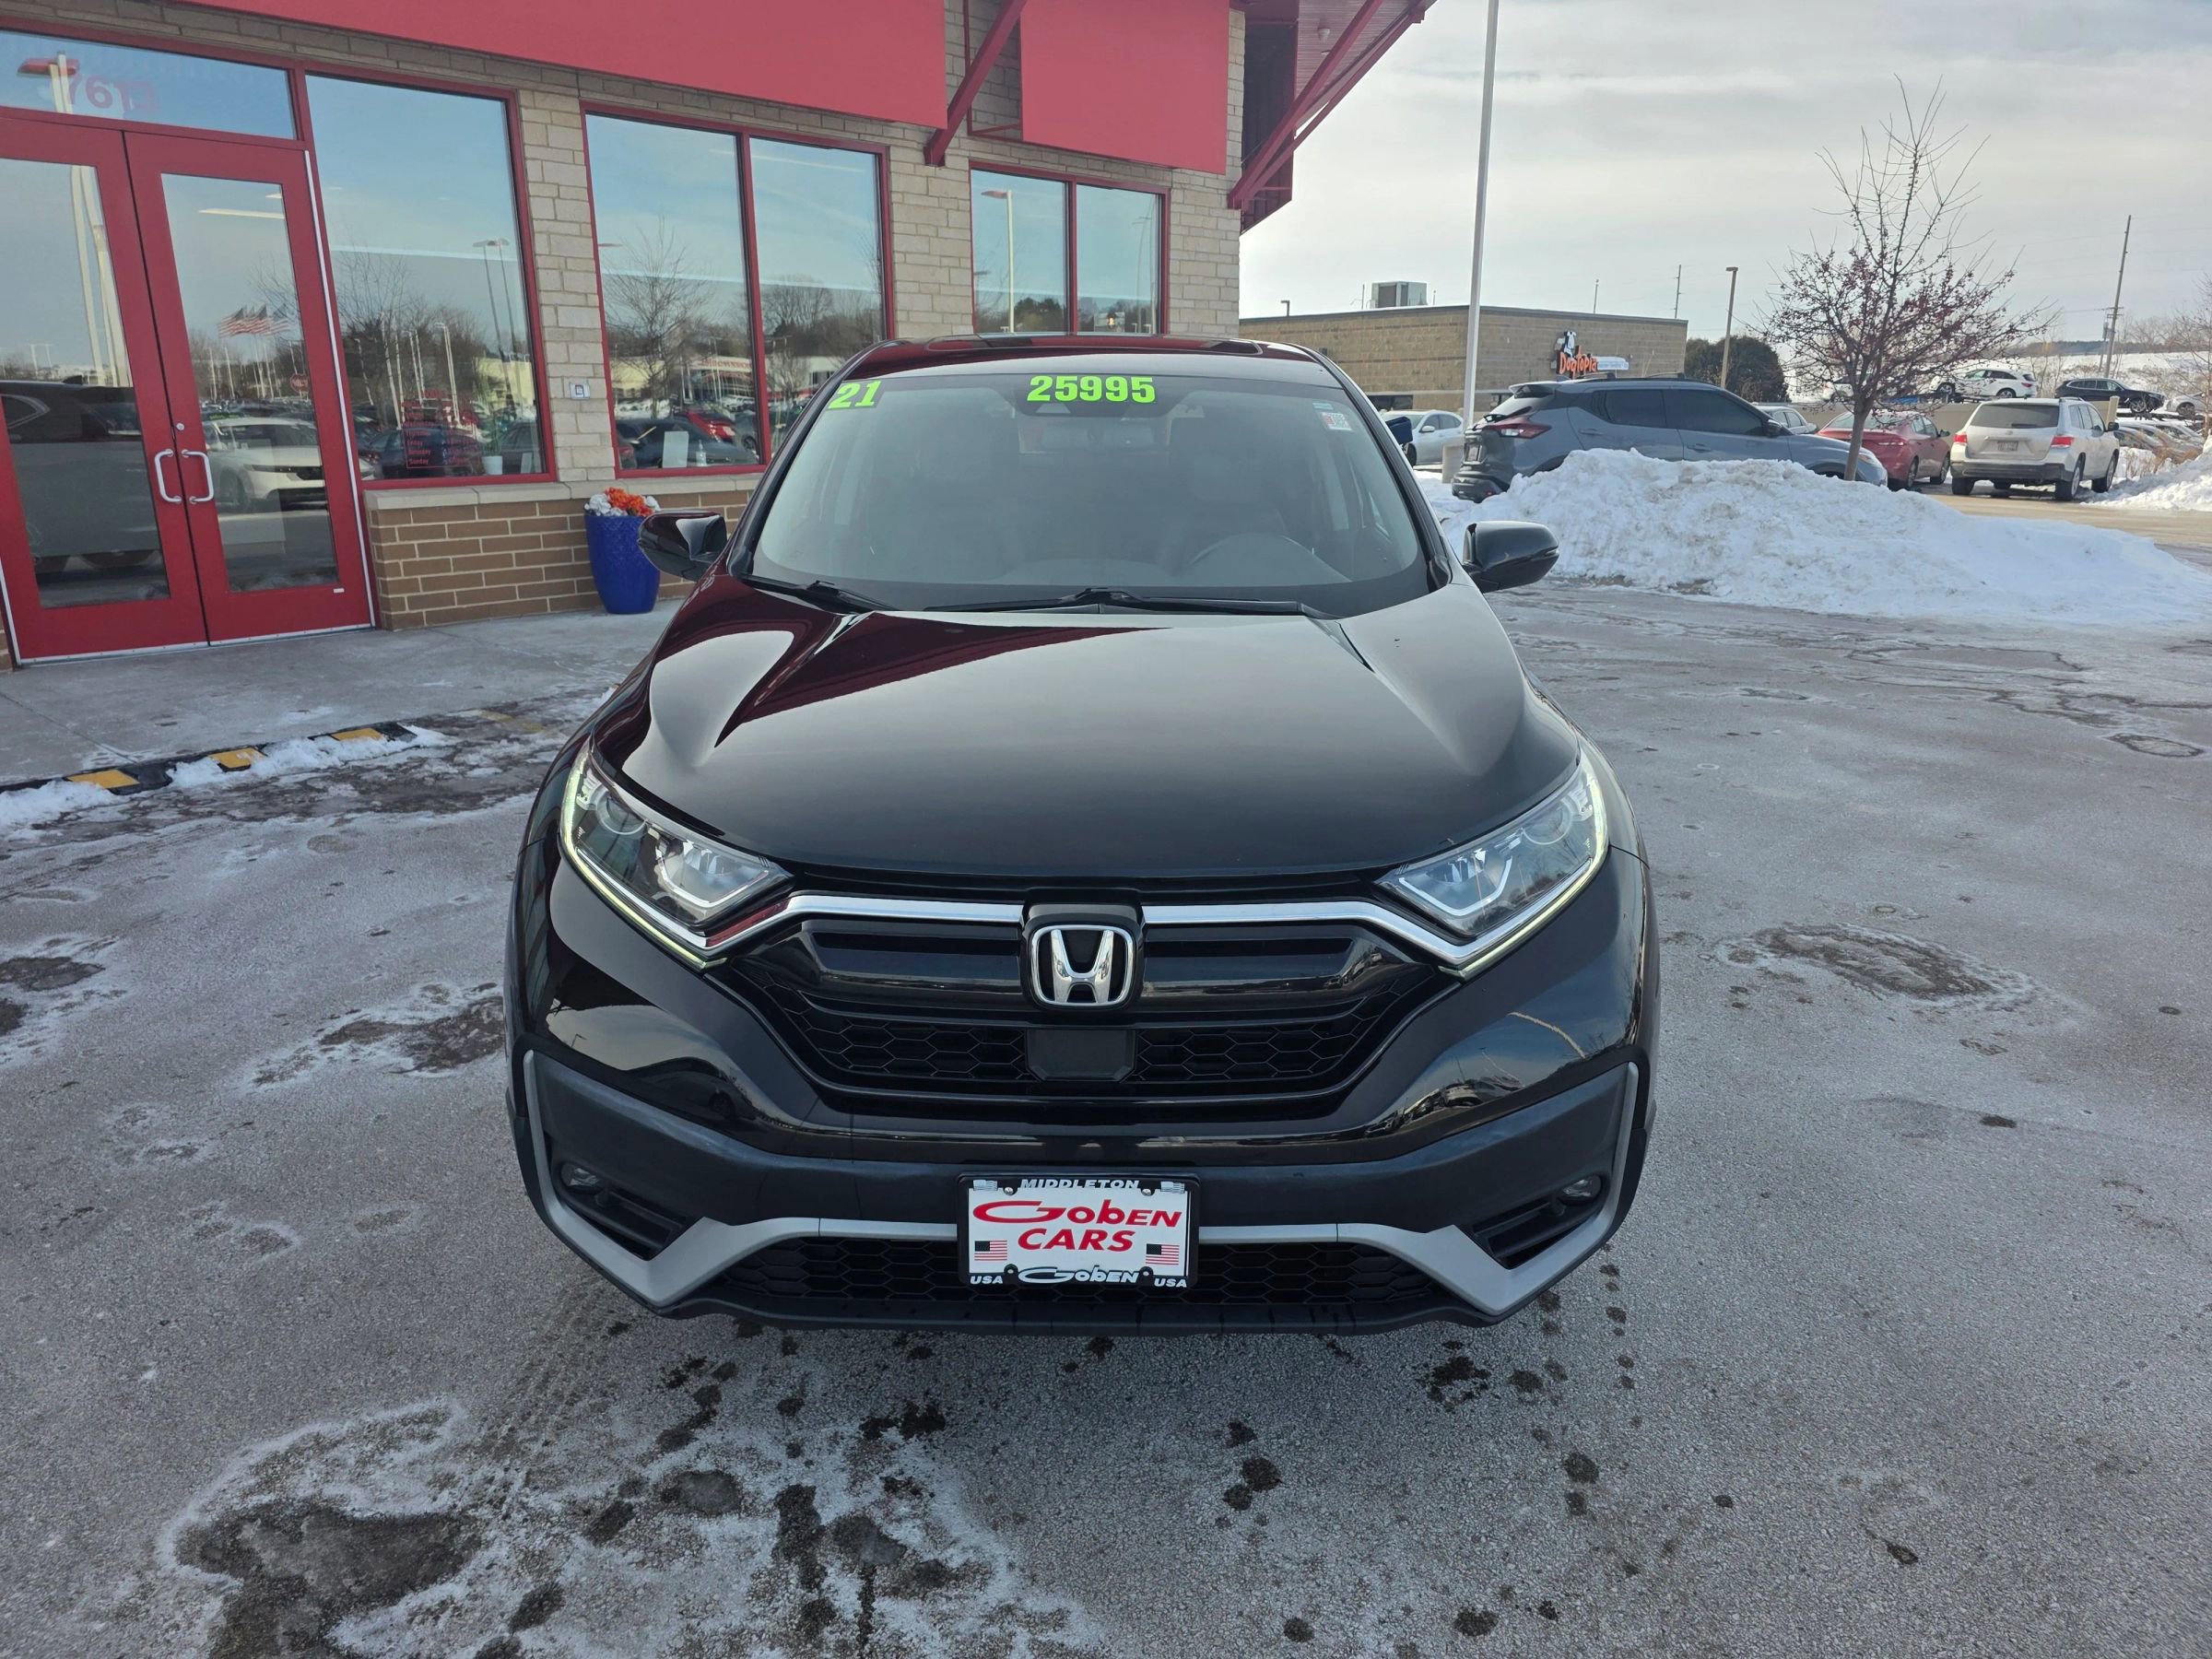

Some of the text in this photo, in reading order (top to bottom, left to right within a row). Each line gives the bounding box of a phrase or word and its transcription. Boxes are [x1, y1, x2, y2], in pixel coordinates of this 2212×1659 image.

[1559, 345, 1597, 380] Dogtopia
[828, 380, 882, 409] 21
[1026, 375, 1156, 404] 25995
[1019, 1179, 1139, 1189] MIDDLETON
[1018, 1228, 1135, 1253] CARS
[970, 1275, 1004, 1285] USA
[1154, 1277, 1188, 1288] USA
